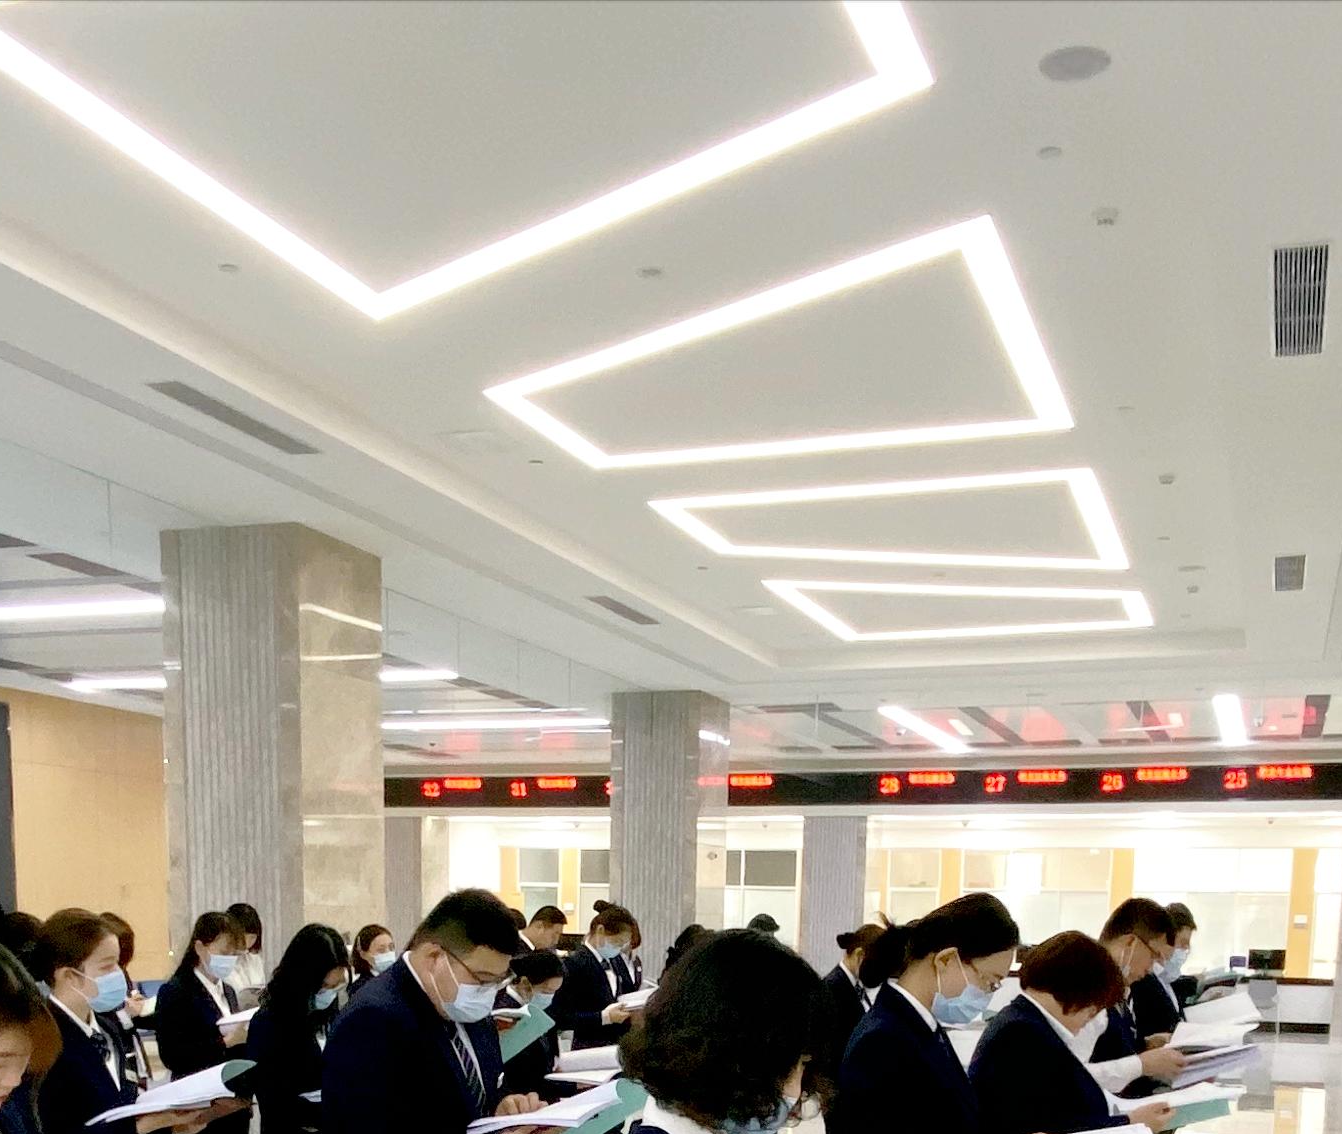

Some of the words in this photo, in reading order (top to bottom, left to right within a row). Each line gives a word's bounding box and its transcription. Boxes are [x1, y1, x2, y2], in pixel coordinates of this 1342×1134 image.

[984, 774, 1007, 793] 27
[1102, 773, 1124, 792] 26
[1224, 770, 1249, 790] 25
